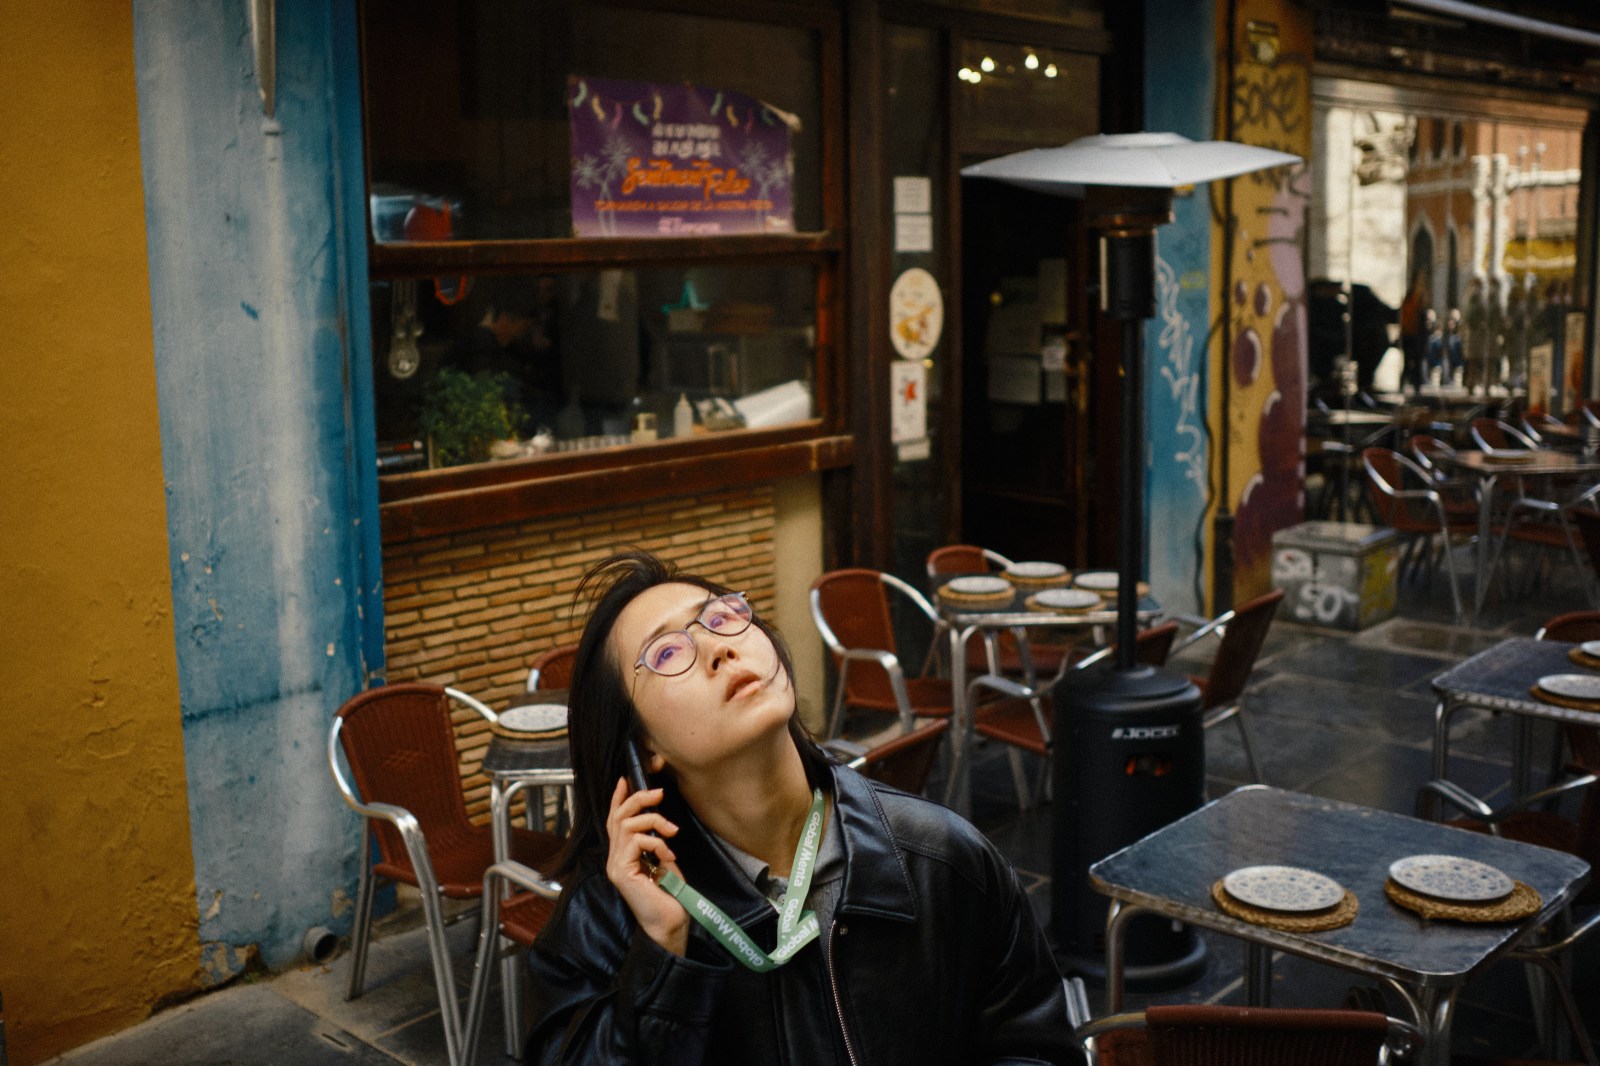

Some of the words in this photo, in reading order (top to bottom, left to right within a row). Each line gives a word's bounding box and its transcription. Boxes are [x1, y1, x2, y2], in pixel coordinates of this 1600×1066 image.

[804, 811, 821, 851] Global
[793, 849, 814, 887] Menta
[696, 899, 730, 935] Menta
[781, 898, 799, 934] Global
[728, 930, 765, 967] Global
